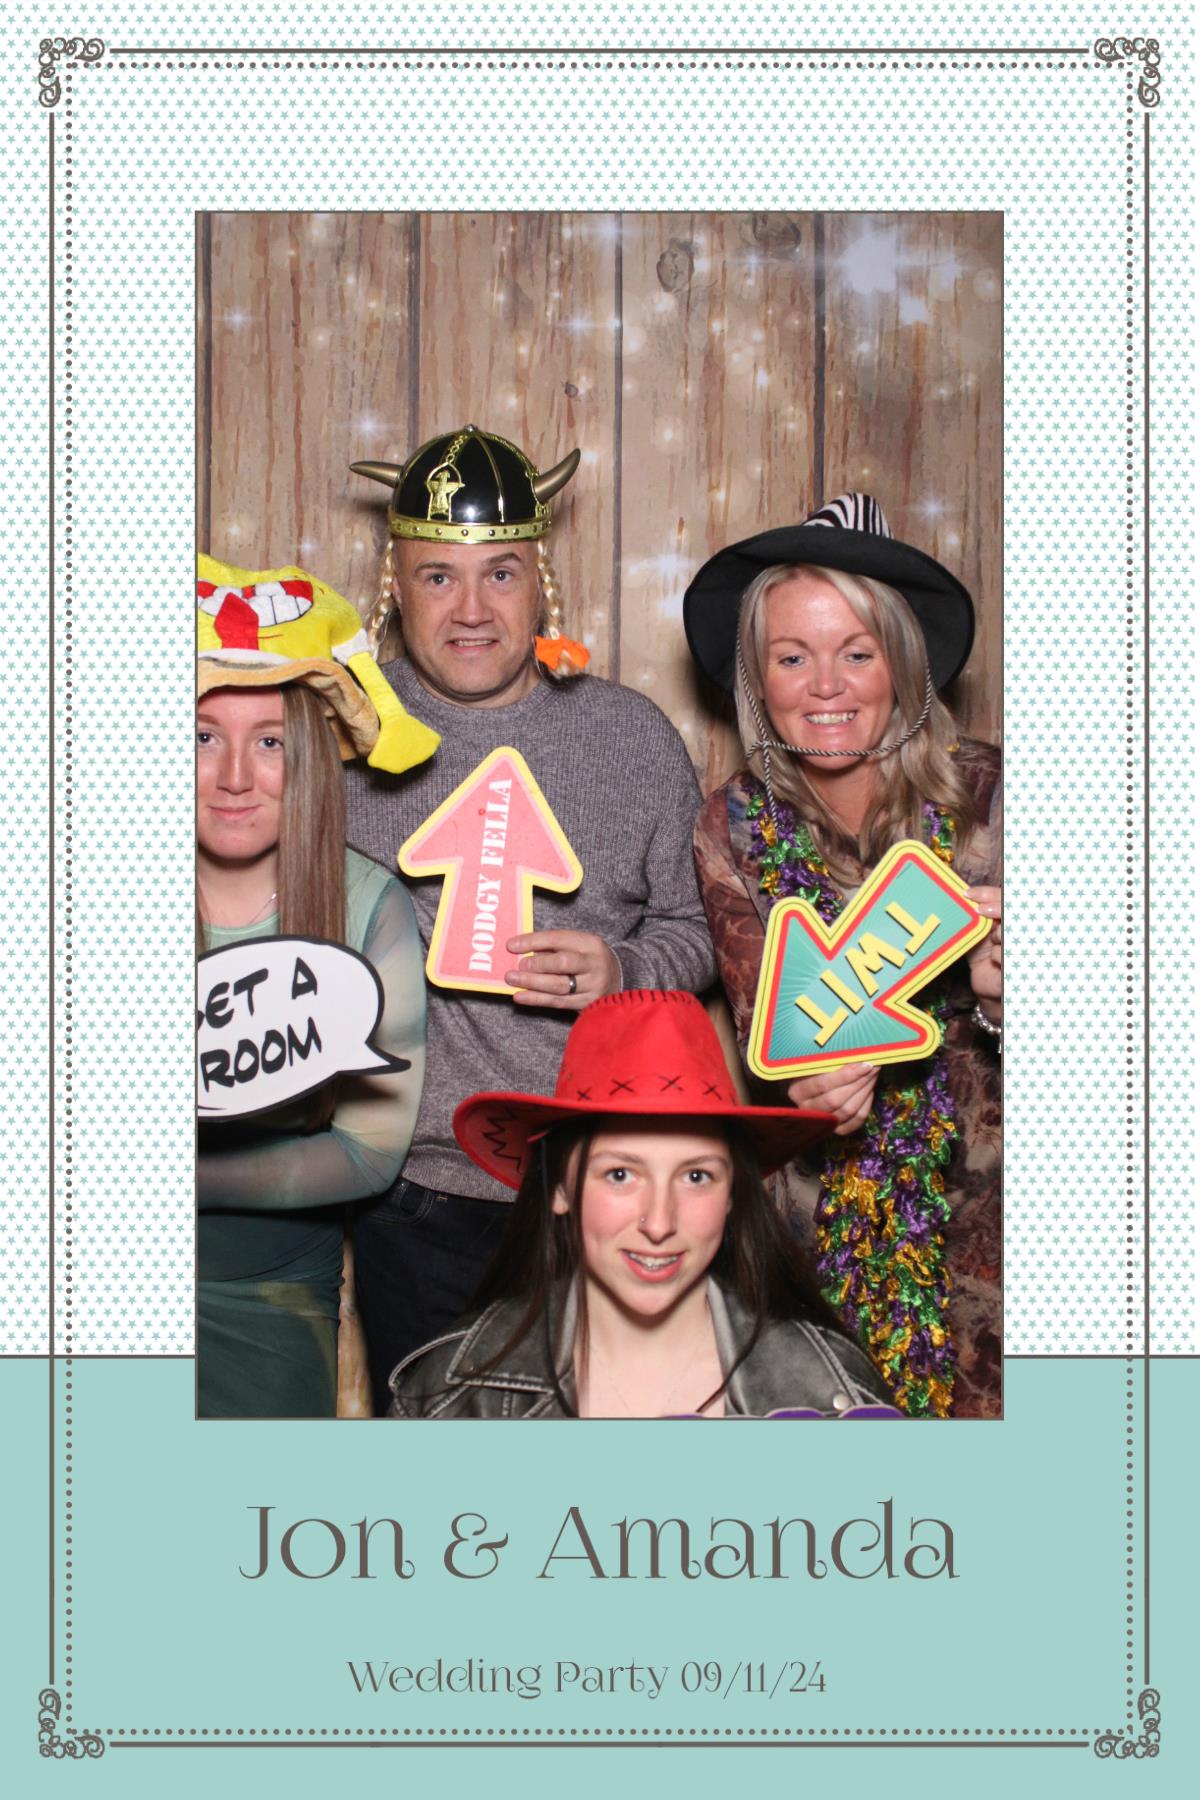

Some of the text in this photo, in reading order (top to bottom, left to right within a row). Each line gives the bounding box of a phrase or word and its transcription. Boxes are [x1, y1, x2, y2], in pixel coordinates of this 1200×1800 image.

[468, 778, 513, 974] DODGY FELLA
[198, 956, 318, 1031] ET A
[793, 901, 942, 1049] TWIT
[200, 1016, 322, 1092] ROOM
